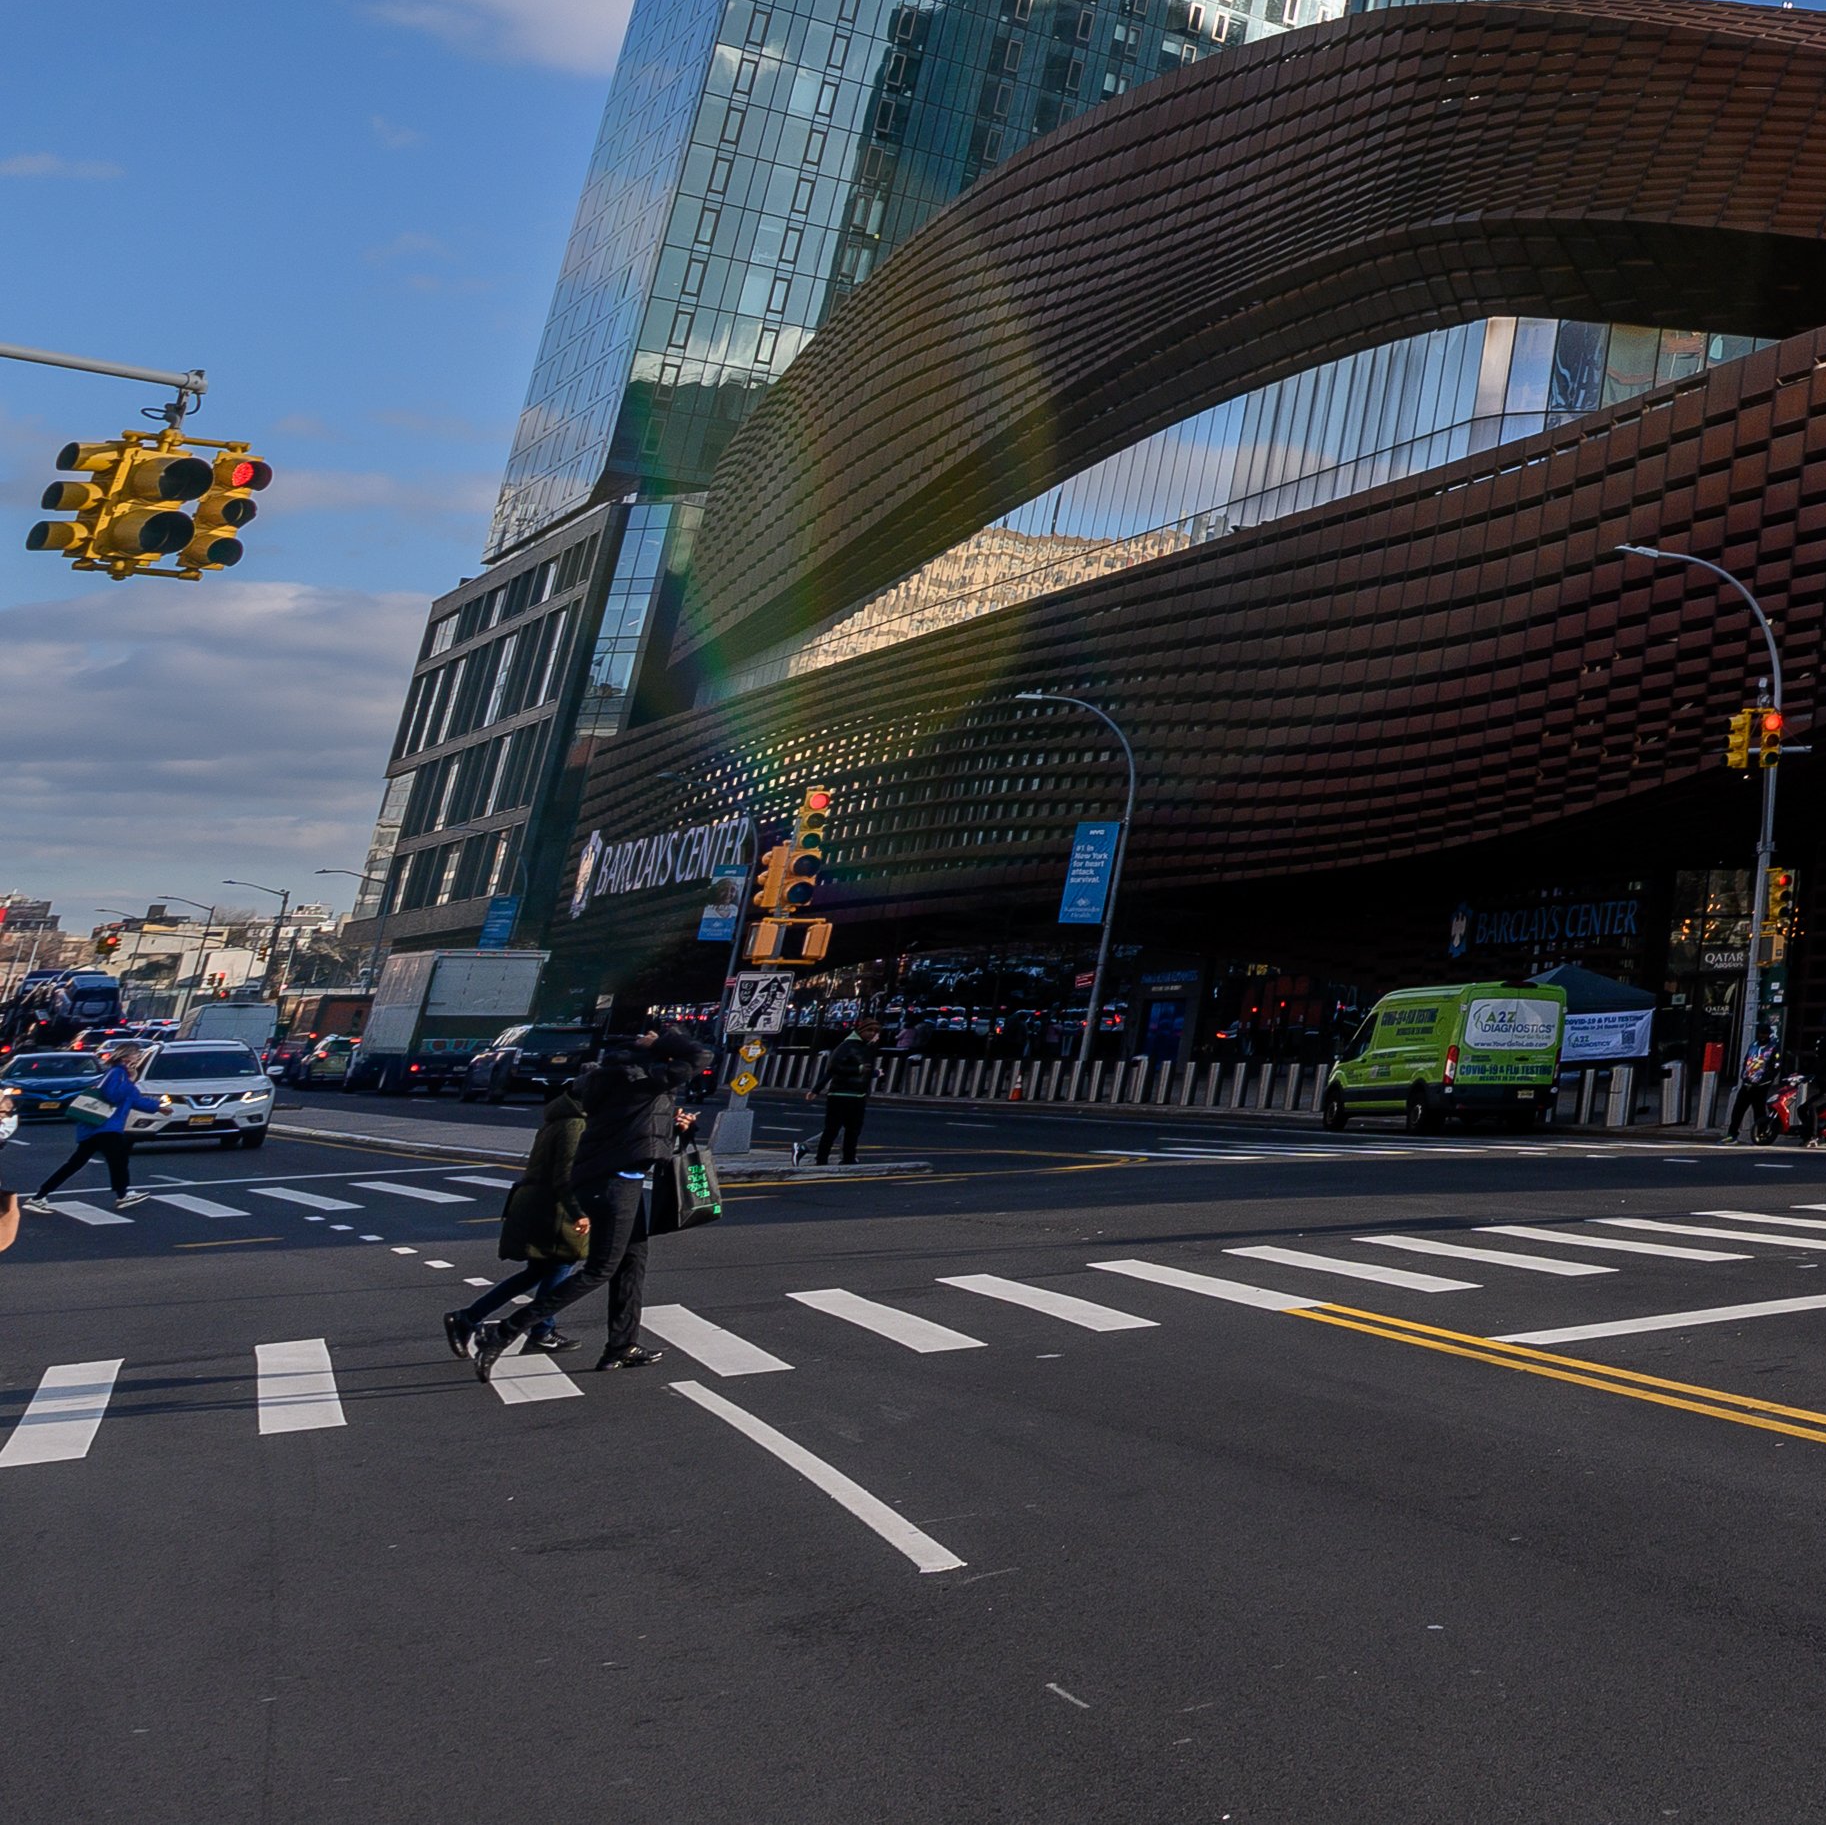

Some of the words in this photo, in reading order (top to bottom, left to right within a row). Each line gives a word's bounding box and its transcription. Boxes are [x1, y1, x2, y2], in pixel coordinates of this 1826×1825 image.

[593, 830, 679, 897] BARCLAYS
[675, 817, 750, 884] CENTER
[1475, 905, 1562, 944] BARCLAYS
[1564, 899, 1640, 938] CENTER
[1704, 951, 1744, 964] QATAR
[1486, 1011, 1517, 1023] A2Z
[1565, 1017, 1596, 1025] COVID-19
[1604, 1016, 1616, 1024] FLU
[1460, 1064, 1498, 1075] COVID-19
[1506, 1064, 1519, 1074] FLU
